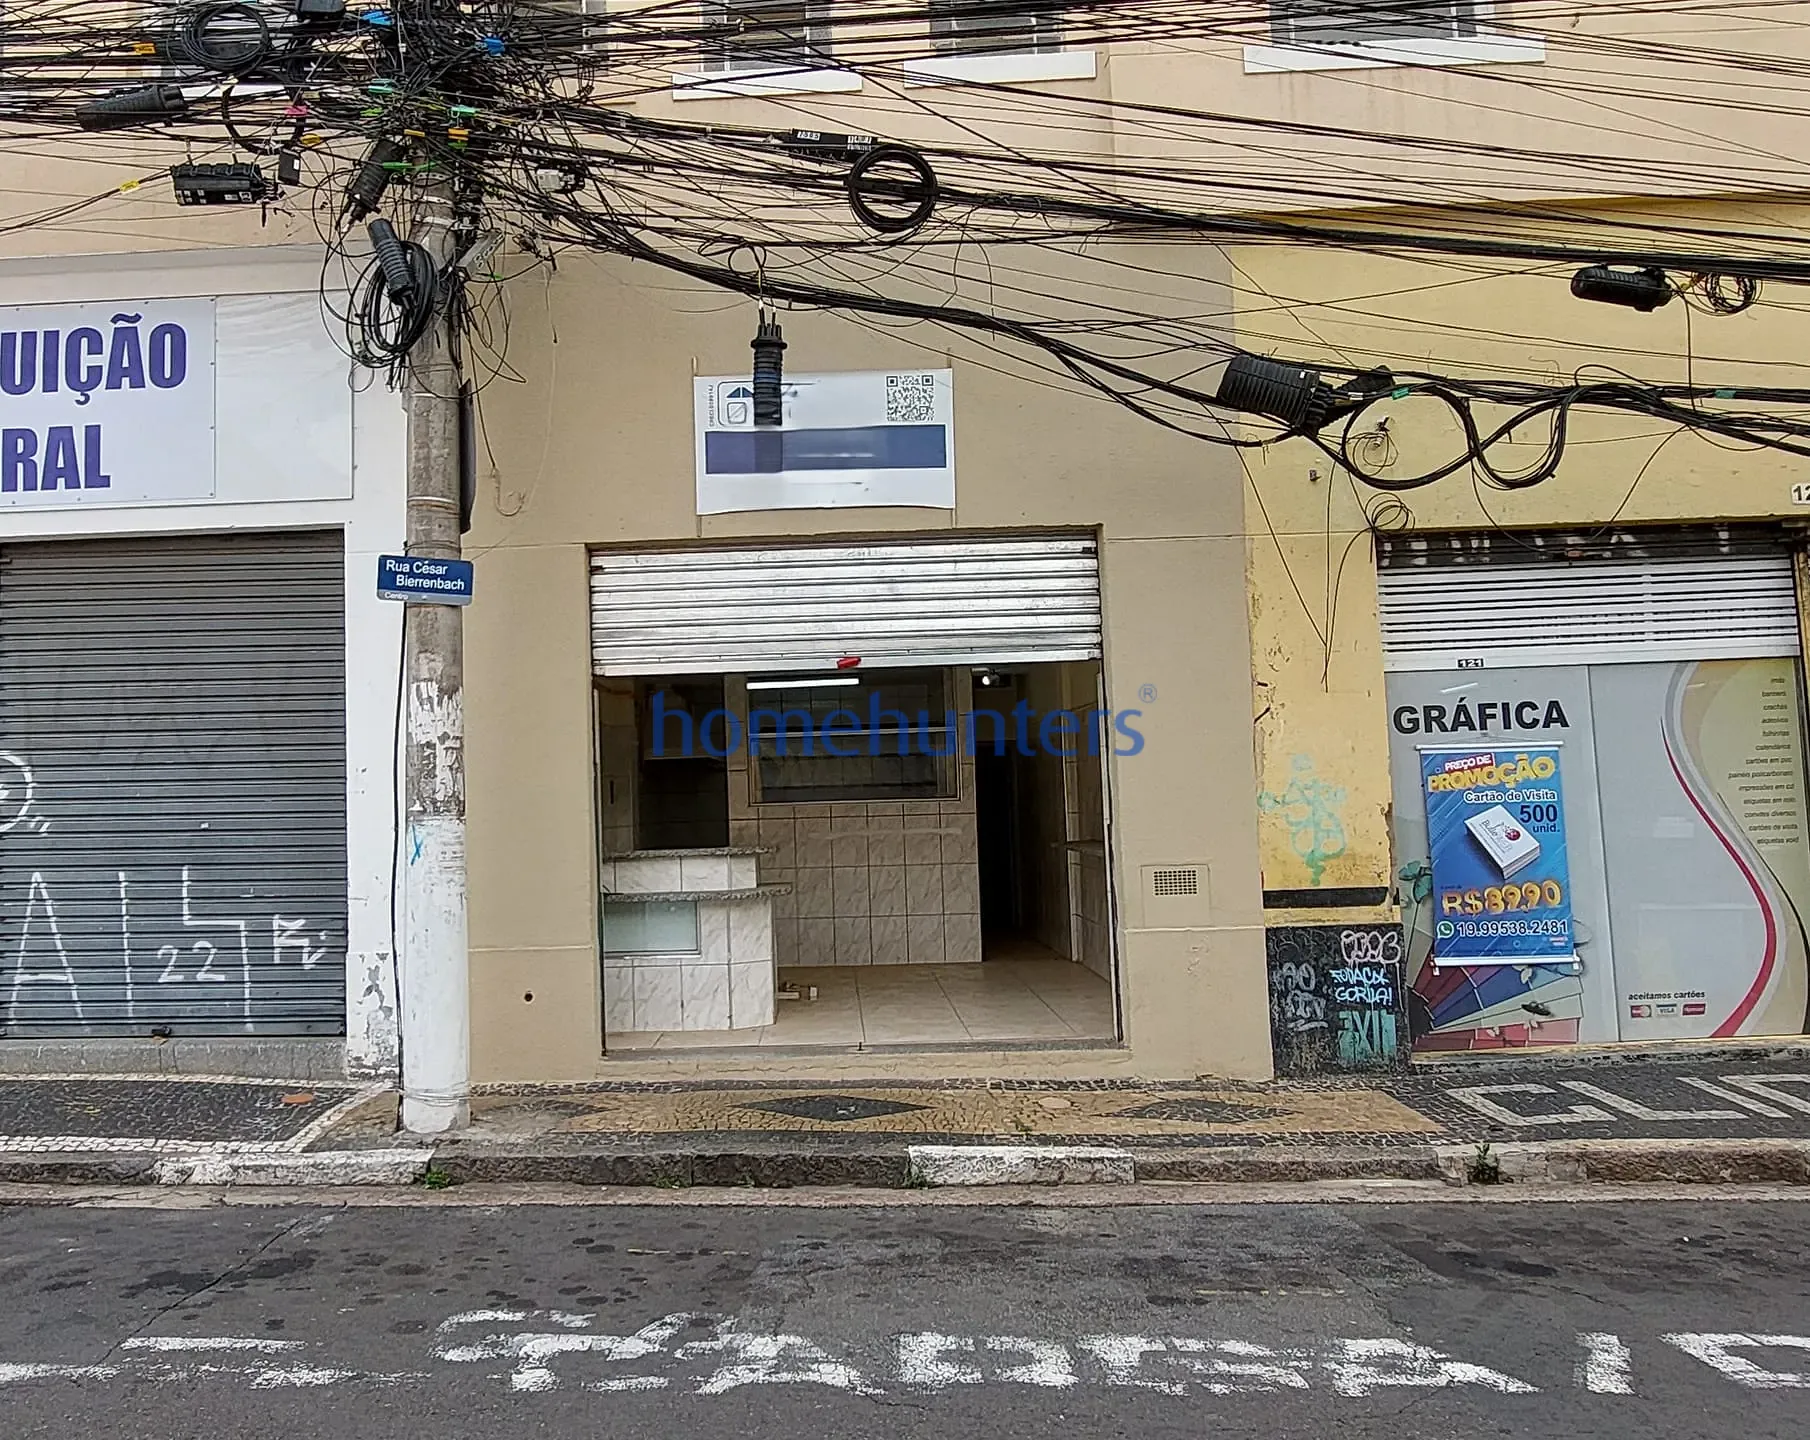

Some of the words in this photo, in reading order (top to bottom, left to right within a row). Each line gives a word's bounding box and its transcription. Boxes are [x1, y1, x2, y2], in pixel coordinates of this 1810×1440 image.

[0, 313, 187, 405] UIÇÃO
[1, 424, 111, 492] RAL
[386, 559, 410, 572] Rua
[412, 560, 448, 574] César
[396, 574, 465, 590] Bierrenbach
[384, 592, 409, 600] Centro
[1459, 659, 1482, 667] 121
[1393, 696, 1570, 734] GRÁFICA
[1444, 757, 1476, 771] PREÇO
[1477, 754, 1492, 766] DE
[1428, 753, 1556, 792] PROMOÇÃO
[1464, 789, 1504, 803] Cartão
[1506, 789, 1522, 802] de
[1522, 788, 1558, 801] Visita
[1520, 804, 1558, 823] 500
[1533, 823, 1561, 833] unid.
[1456, 919, 1569, 937] 19.99538.2481
[1628, 992, 1671, 1000] aceitamos
[1673, 990, 1706, 998] cartões
